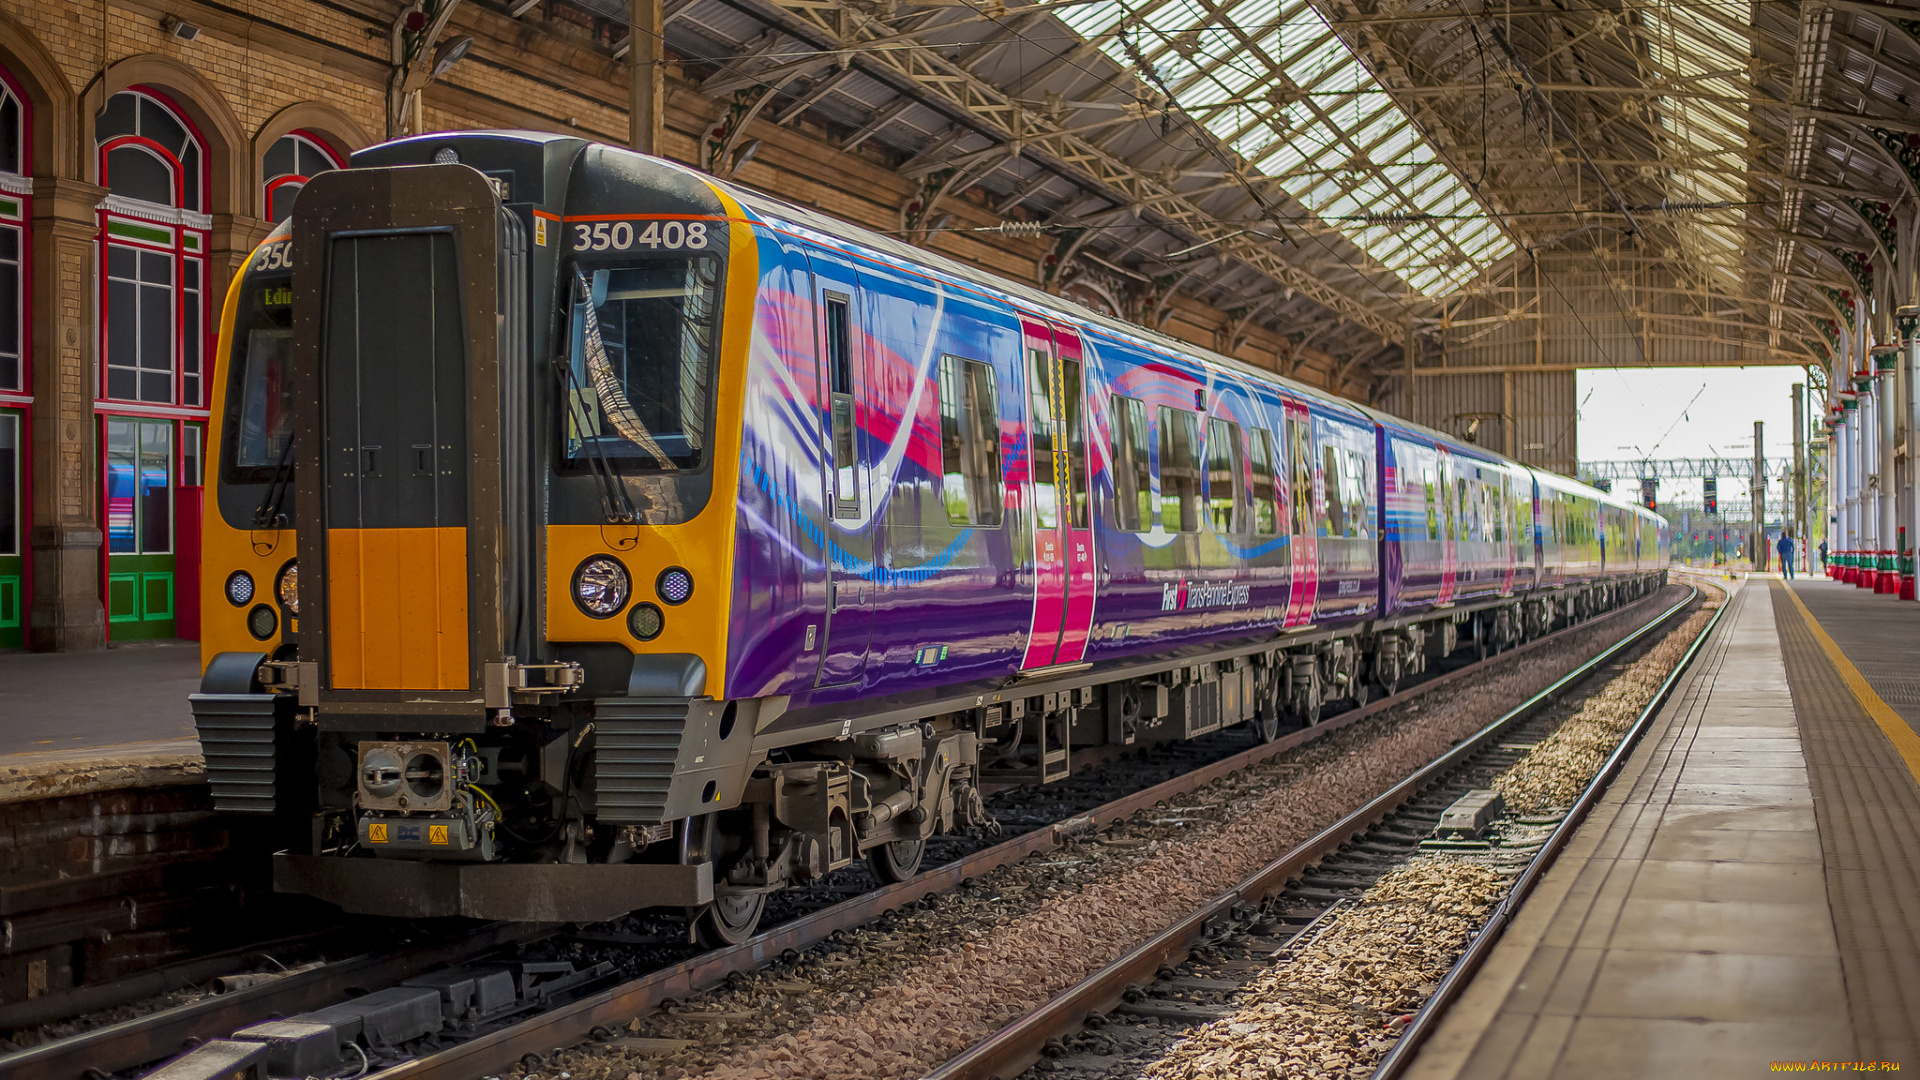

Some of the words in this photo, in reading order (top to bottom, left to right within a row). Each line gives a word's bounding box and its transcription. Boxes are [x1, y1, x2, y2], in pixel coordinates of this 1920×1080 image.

[573, 222, 634, 251] 350
[638, 221, 708, 250] 408
[1161, 582, 1178, 611] First
